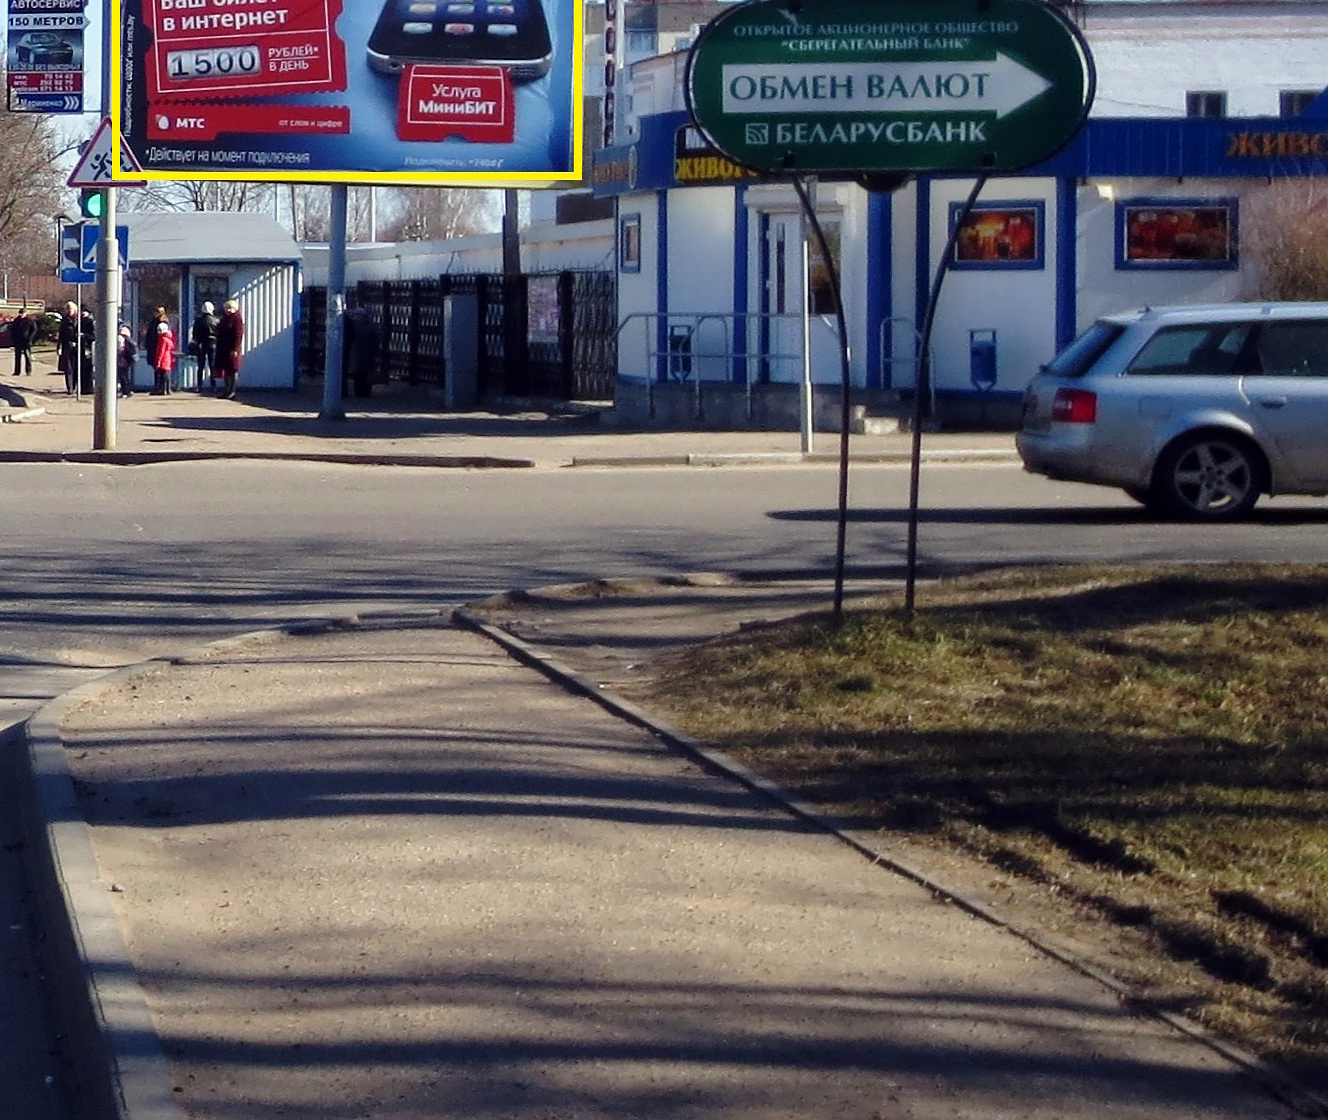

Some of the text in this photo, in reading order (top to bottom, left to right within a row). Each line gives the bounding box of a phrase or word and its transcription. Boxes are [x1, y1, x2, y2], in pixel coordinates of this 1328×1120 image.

[10, 0, 81, 9] АВТОСЕРВИС
[9, 16, 84, 26] 150 МЕТРОВ
[163, 9, 289, 32] в интернет
[733, 21, 1019, 37] ОТКРЫТОЕ АКЦИОНЕРНОЕ ОБЩЕСТВО
[171, 50, 256, 77] 1500
[269, 60, 309, 73] В ДЕНЬ
[432, 83, 481, 100] Услуга
[729, 73, 990, 101] ОБМЕН ВАЛЮТ
[418, 100, 496, 115] МиниБИТ
[176, 117, 205, 129] МТС
[279, 119, 288, 127] от
[776, 121, 987, 144] БЕЛАРУСБАНК
[198, 150, 209, 161] на
[212, 150, 246, 162] момент
[248, 150, 310, 165] подключения
